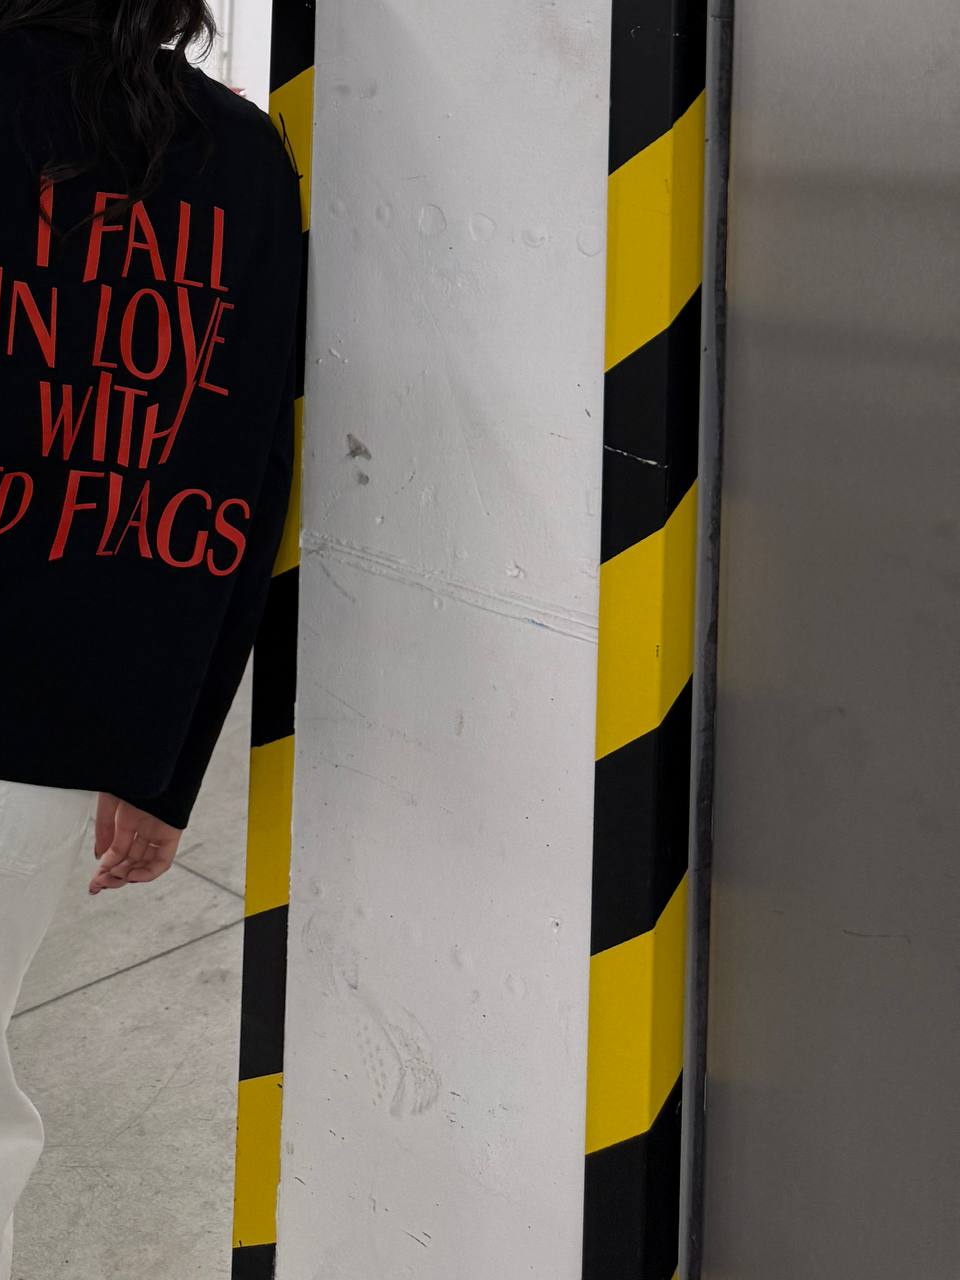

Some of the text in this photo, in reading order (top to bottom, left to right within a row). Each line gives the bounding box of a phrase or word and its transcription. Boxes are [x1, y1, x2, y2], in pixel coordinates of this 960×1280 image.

[37, 175, 229, 292] I FALL
[92, 283, 235, 396] LOVE
[40, 371, 185, 469] WITH
[48, 469, 251, 576] FLAGS
